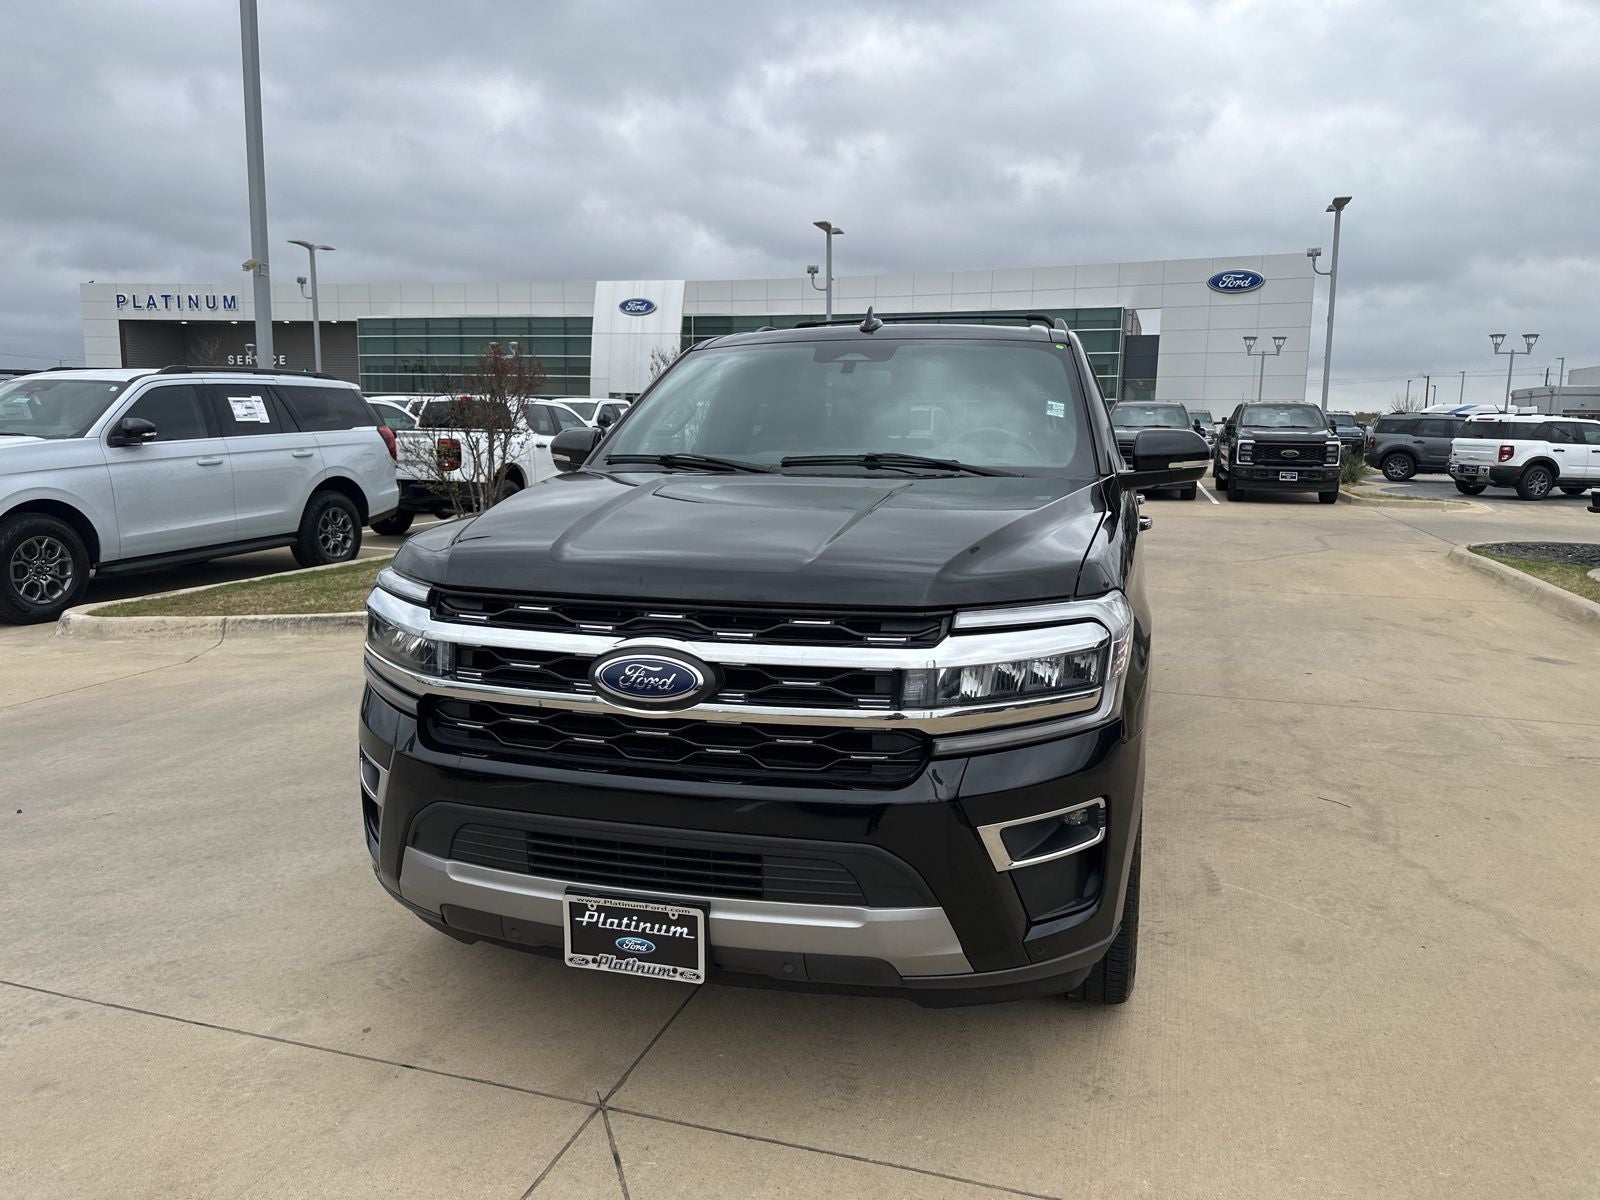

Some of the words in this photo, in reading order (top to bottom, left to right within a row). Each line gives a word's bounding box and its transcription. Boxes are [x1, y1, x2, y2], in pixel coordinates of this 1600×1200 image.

[1219, 274, 1252, 287] Ford
[116, 293, 238, 311] PLATINUM
[626, 301, 646, 311] Ford
[227, 354, 286, 365] SERE
[619, 663, 677, 690] Ford
[576, 897, 690, 914] www.PlatinumFord.com
[575, 911, 695, 938] Platinum
[623, 939, 648, 952] Ford
[597, 954, 677, 978] Platinum
